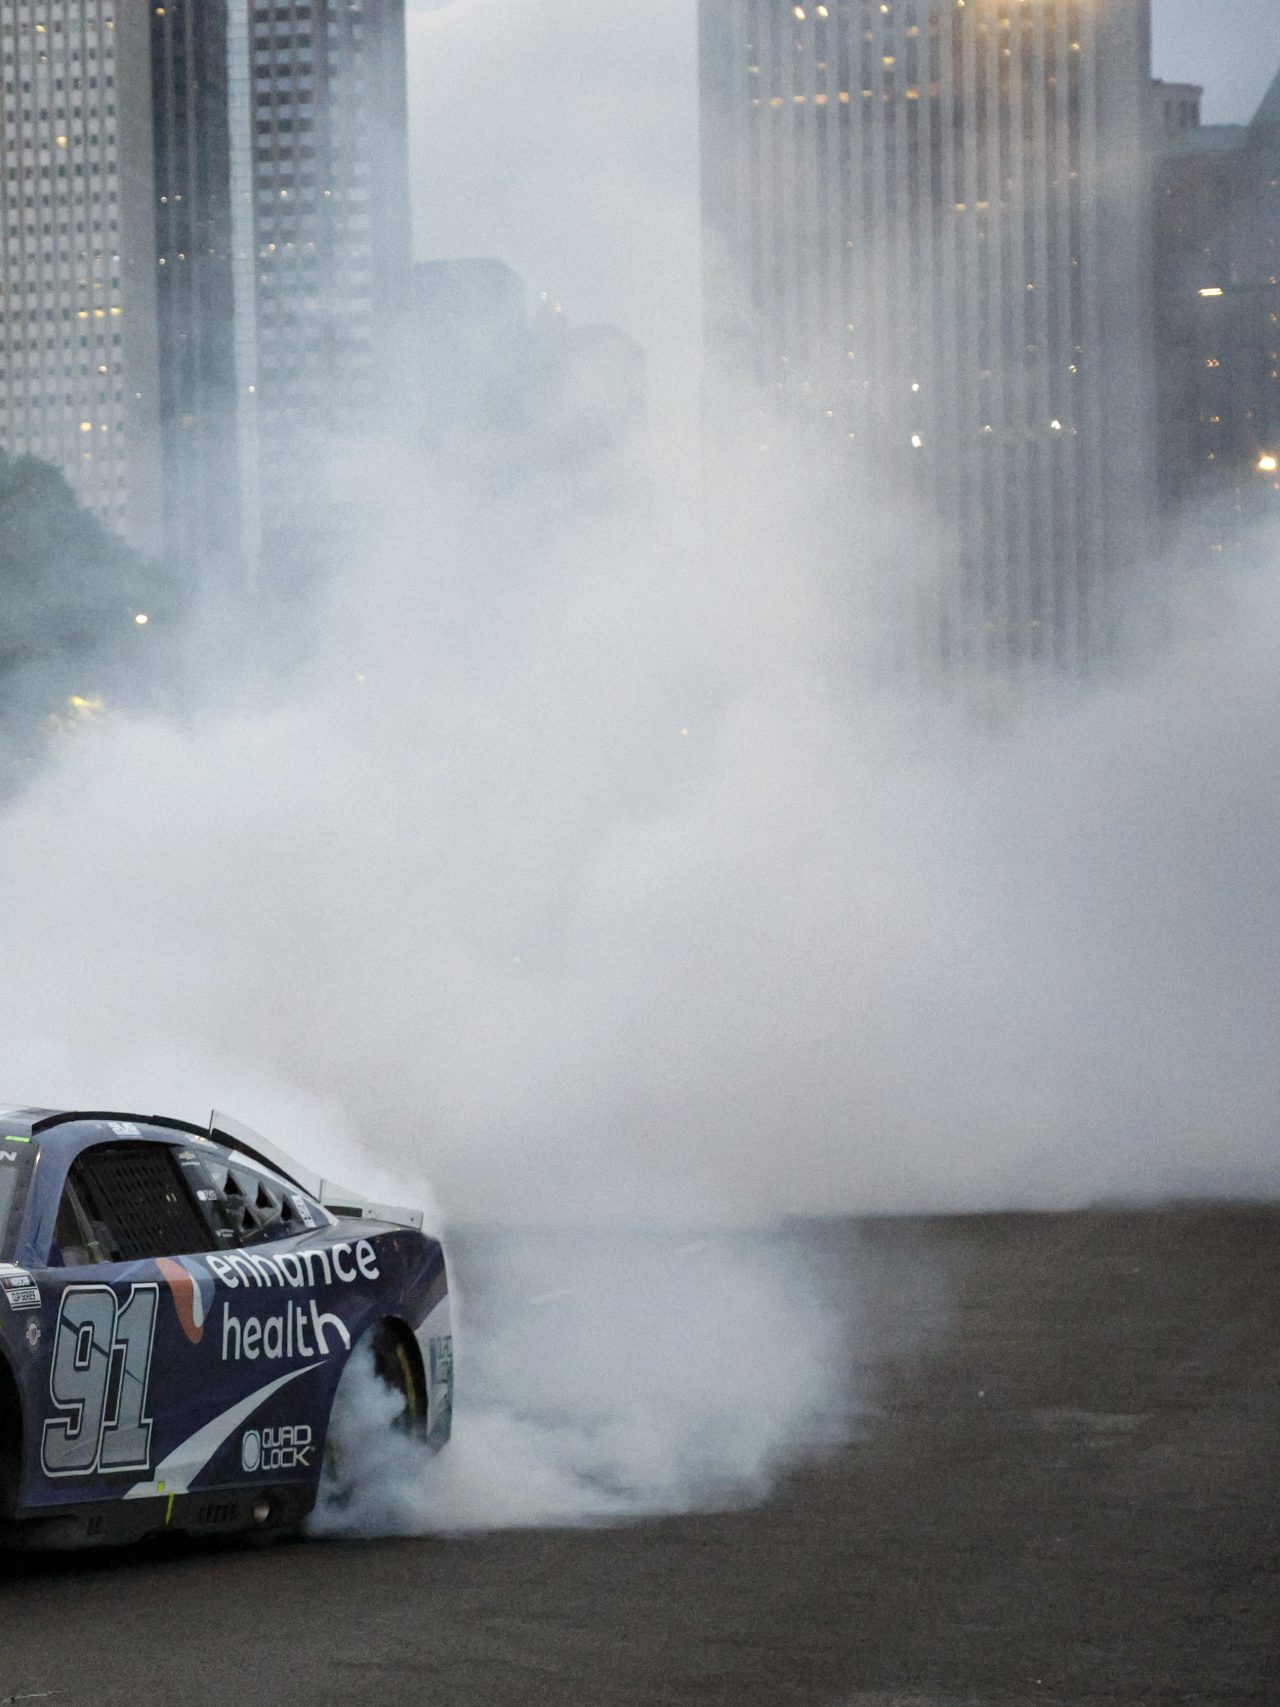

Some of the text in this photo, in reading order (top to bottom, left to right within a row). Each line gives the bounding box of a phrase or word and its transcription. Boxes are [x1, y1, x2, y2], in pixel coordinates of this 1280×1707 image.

[206, 1240, 380, 1289] enhance
[222, 1299, 351, 1360] health
[40, 1282, 160, 1478] 91
[261, 1446, 312, 1470] LOCK
[262, 1424, 313, 1449] QUAD
